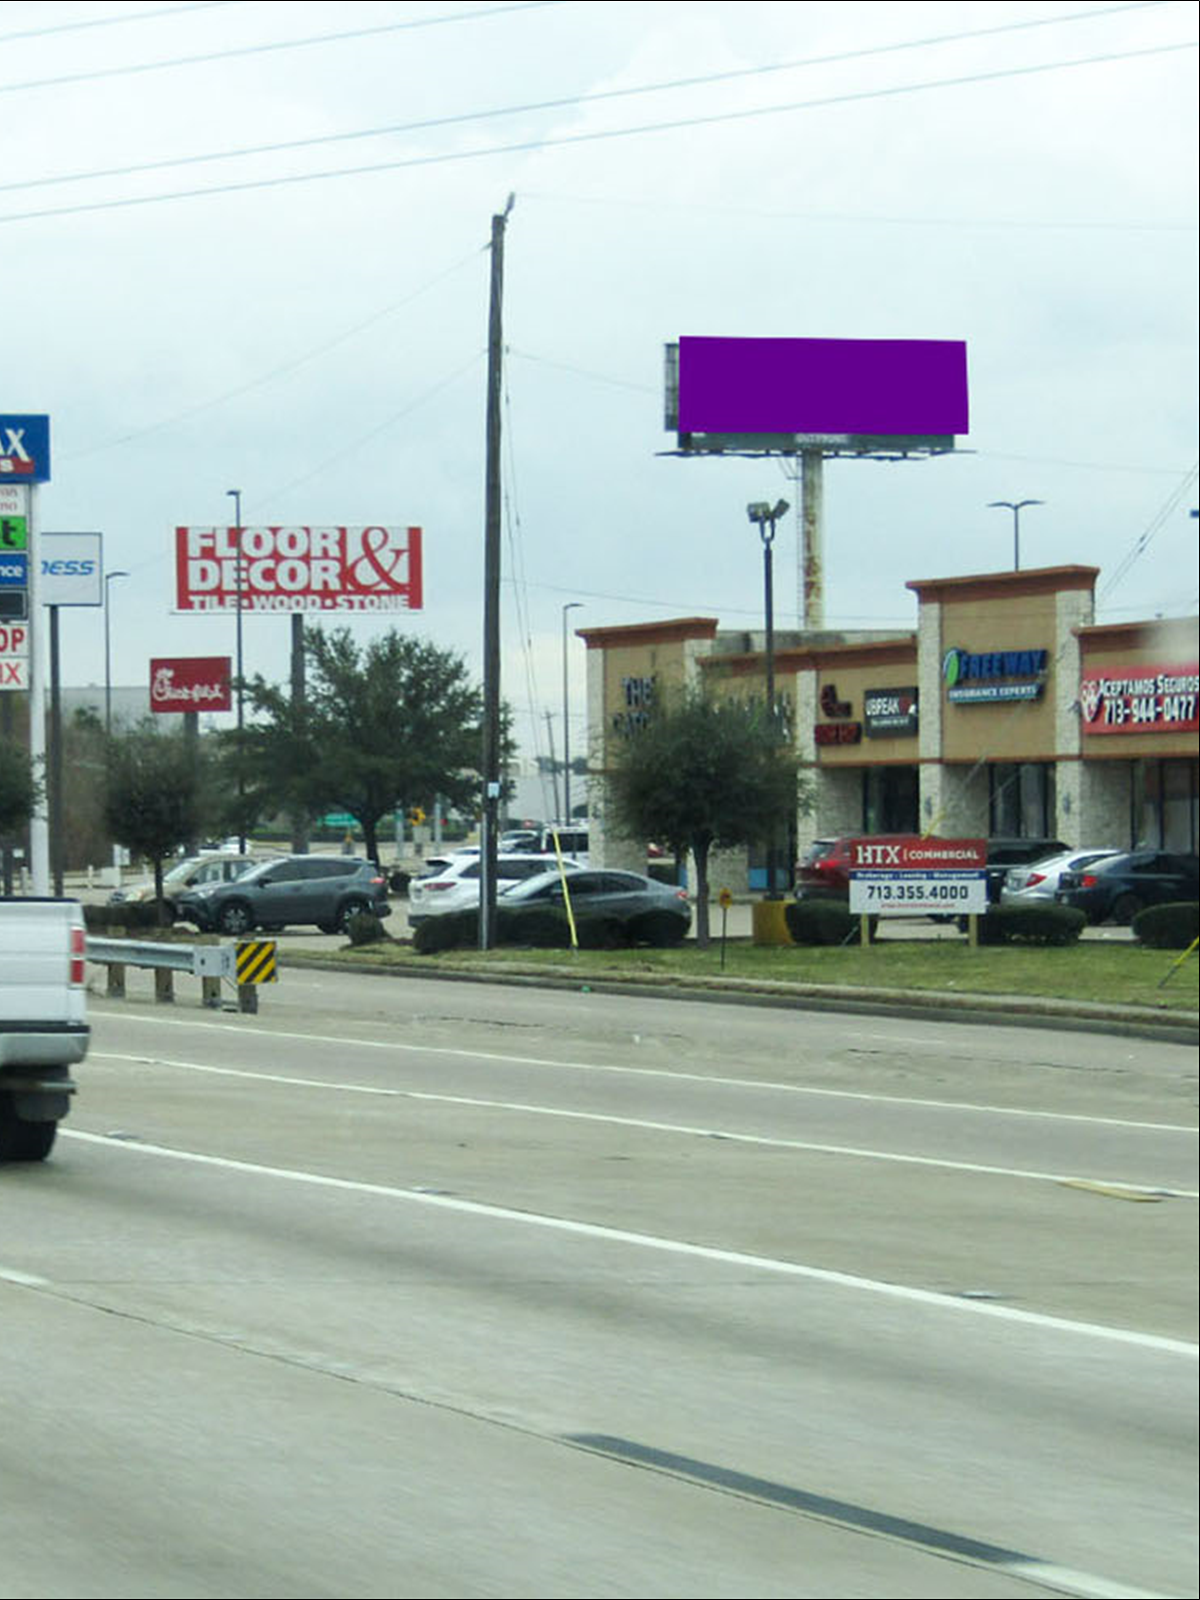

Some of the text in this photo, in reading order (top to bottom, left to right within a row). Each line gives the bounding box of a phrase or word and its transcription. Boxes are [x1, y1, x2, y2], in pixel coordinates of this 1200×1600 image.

[187, 527, 342, 557] FLOOR
[188, 559, 342, 591] DECOR
[959, 650, 1046, 679] FREEWAY
[1099, 678, 1156, 697] ACEPTAMOS
[1104, 695, 1196, 725] 713-944-0477
[856, 845, 979, 864] HTX COMMERCIAL
[867, 886, 969, 899] 713.355.4000
